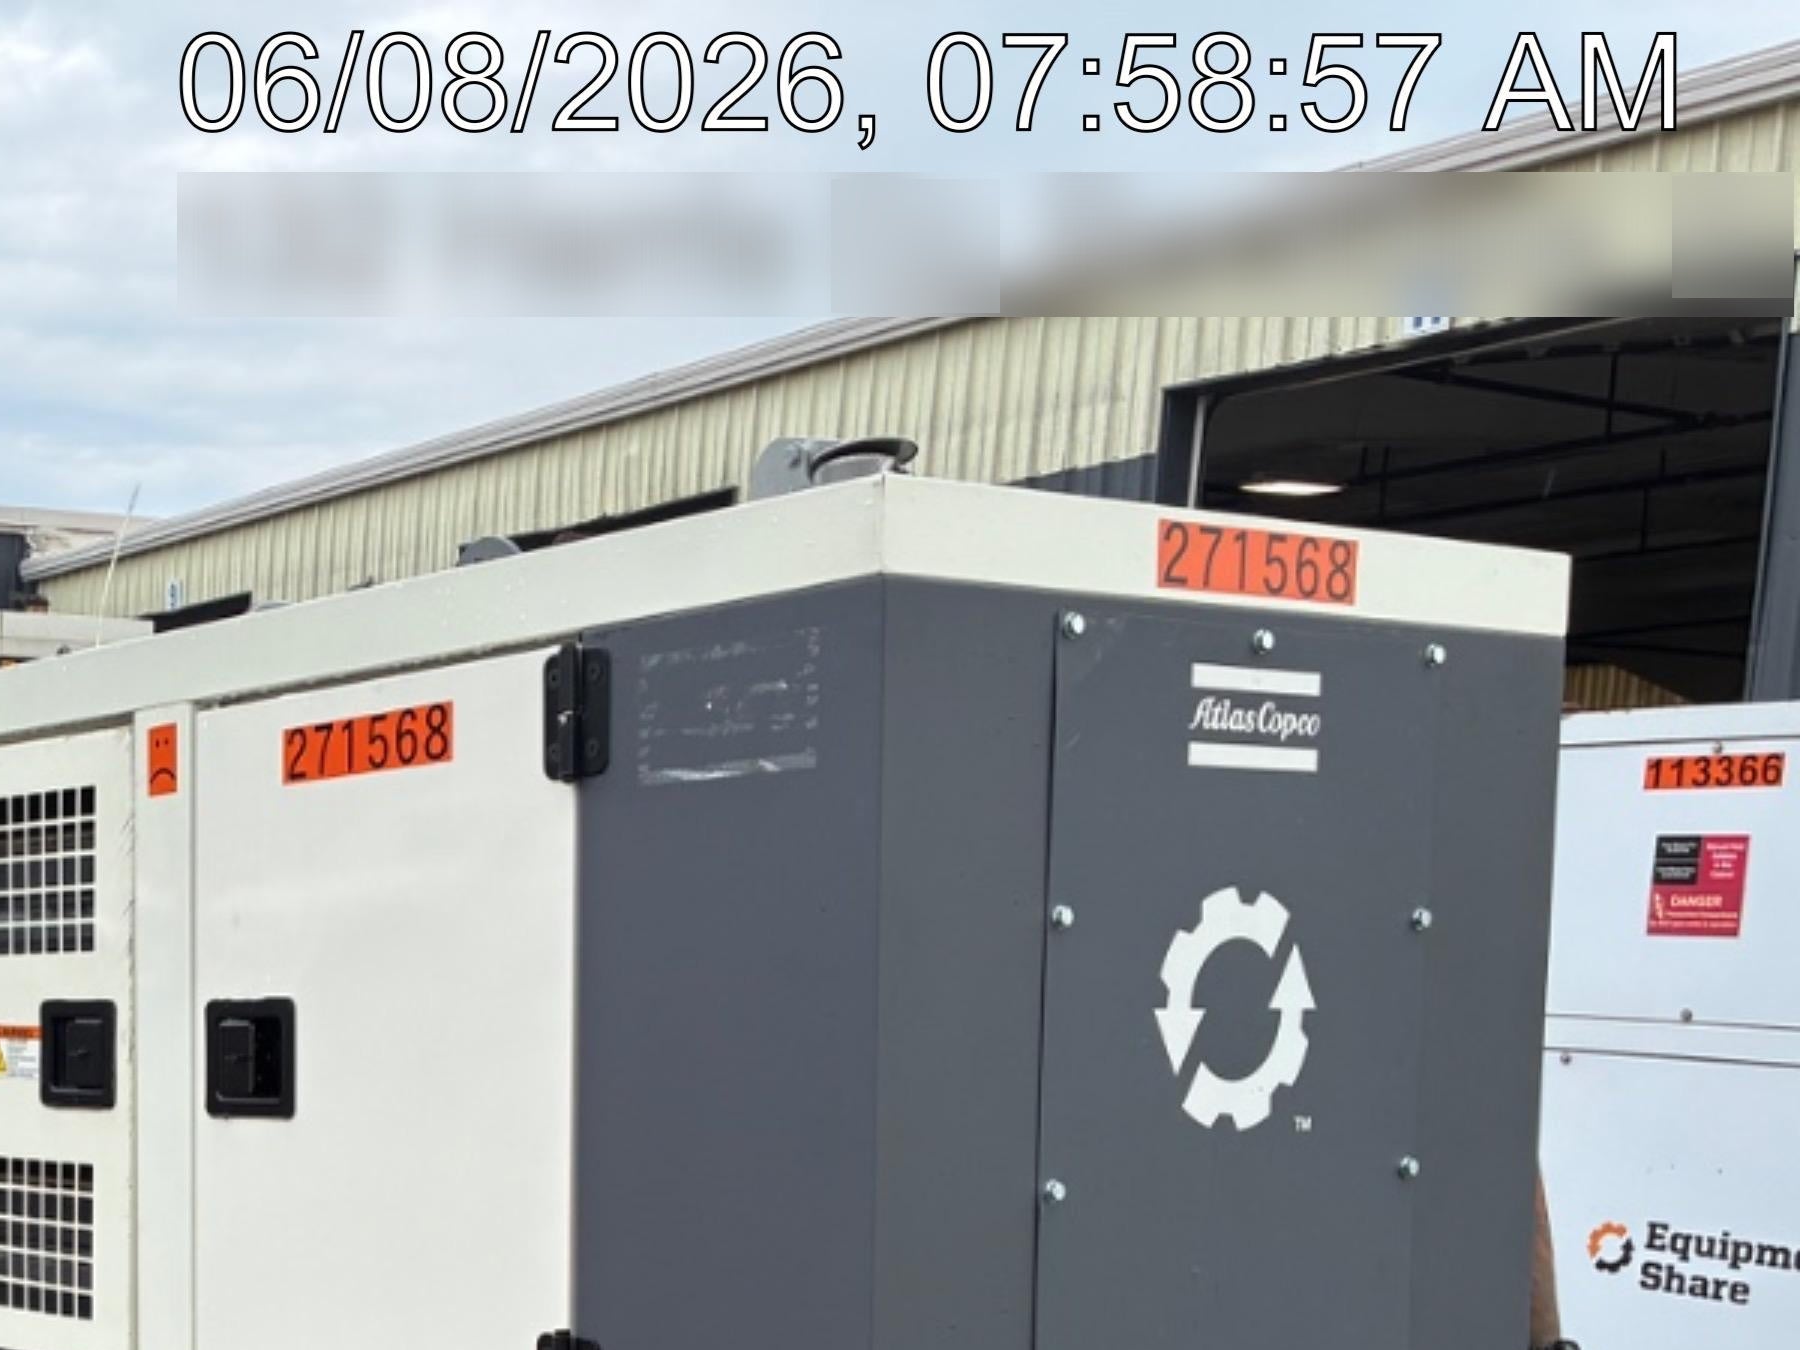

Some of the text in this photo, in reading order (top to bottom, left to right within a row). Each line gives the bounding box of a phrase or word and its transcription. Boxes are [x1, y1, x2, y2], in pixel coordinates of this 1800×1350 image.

[1163, 521, 1352, 601] 271568
[1188, 697, 1321, 742] Atlas Copco
[286, 703, 448, 782] 271568
[1648, 753, 1783, 789] 113366
[1670, 895, 1723, 908] DANGER
[1639, 1261, 1751, 1305] Share
